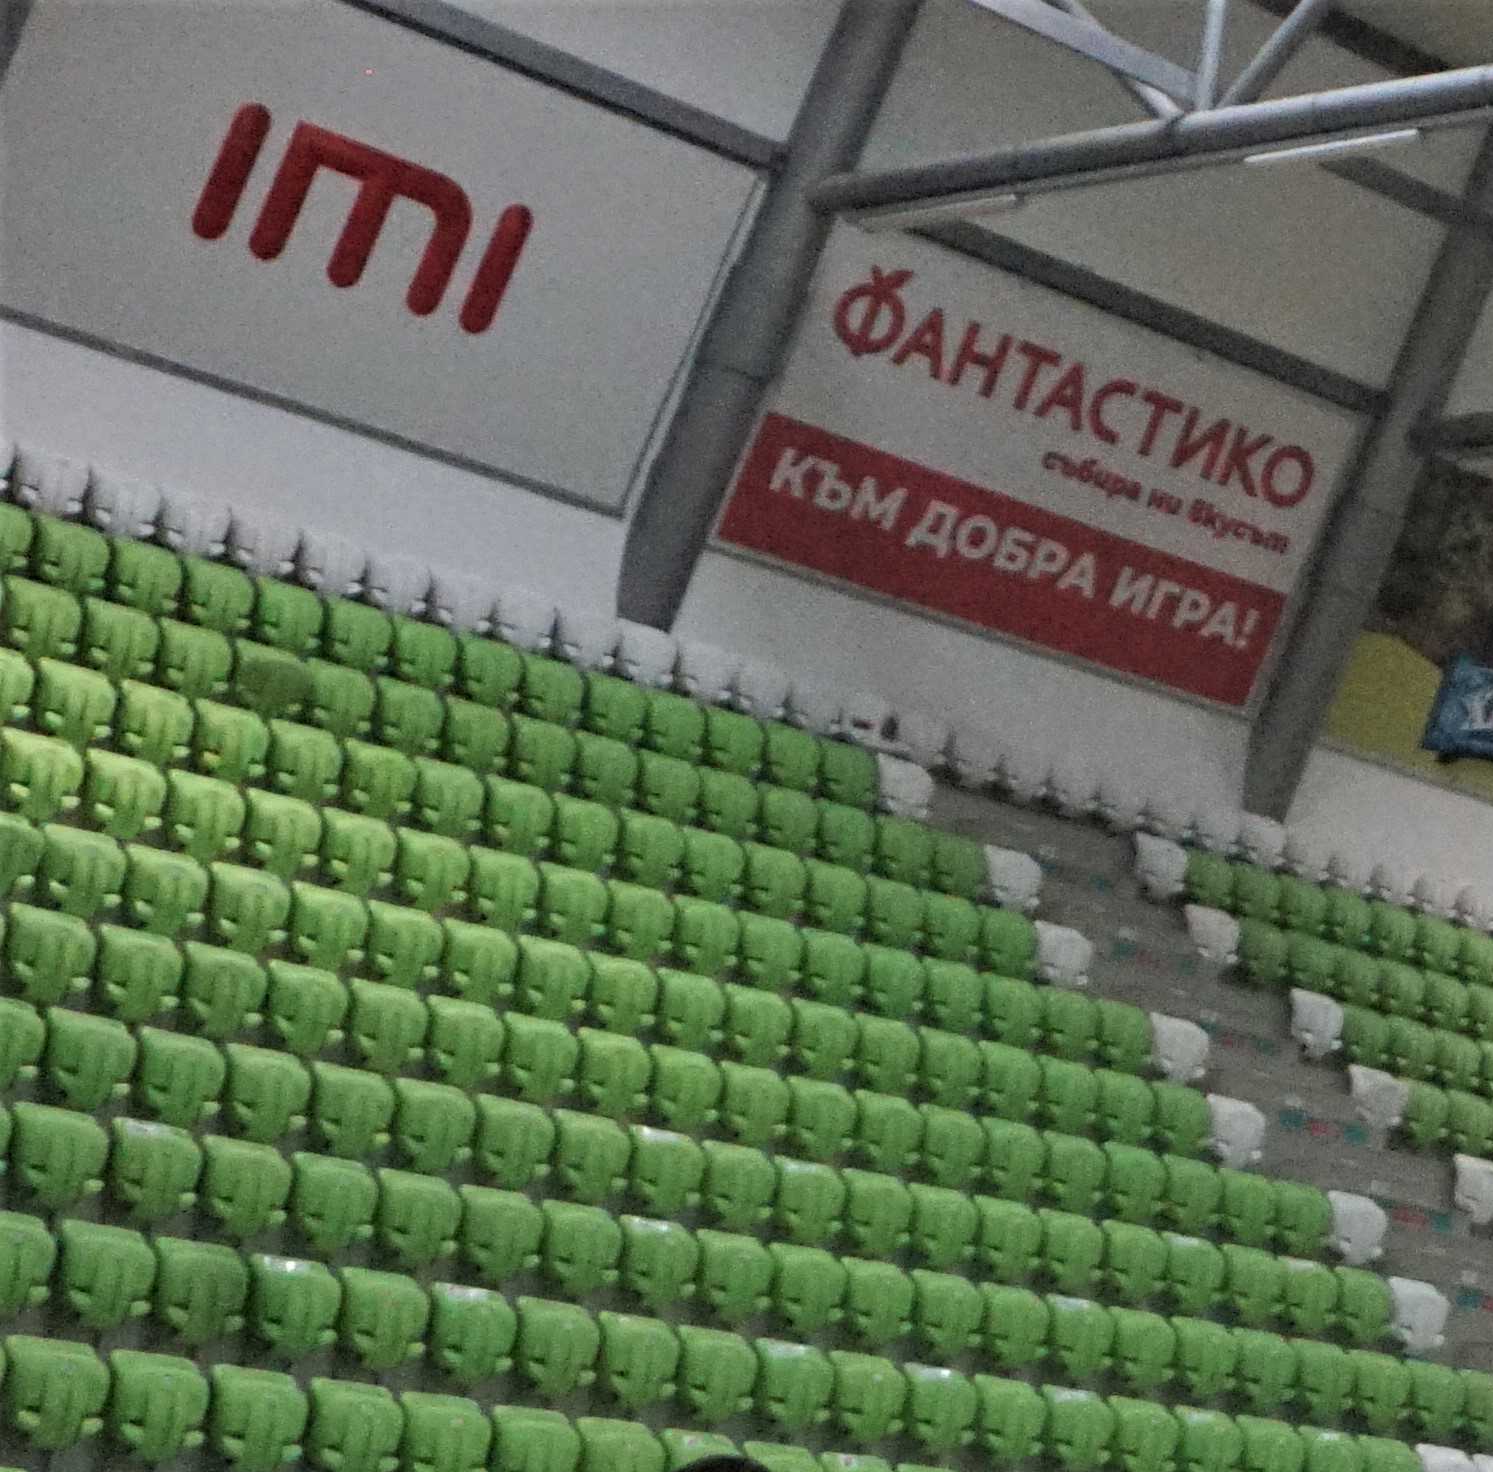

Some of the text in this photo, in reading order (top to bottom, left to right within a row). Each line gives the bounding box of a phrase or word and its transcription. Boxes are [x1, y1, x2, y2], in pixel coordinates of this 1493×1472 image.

[830, 264, 1316, 509] ФАНТАСТИКО
[769, 445, 1263, 652] КЪМ ДОБРА ИГРА!
